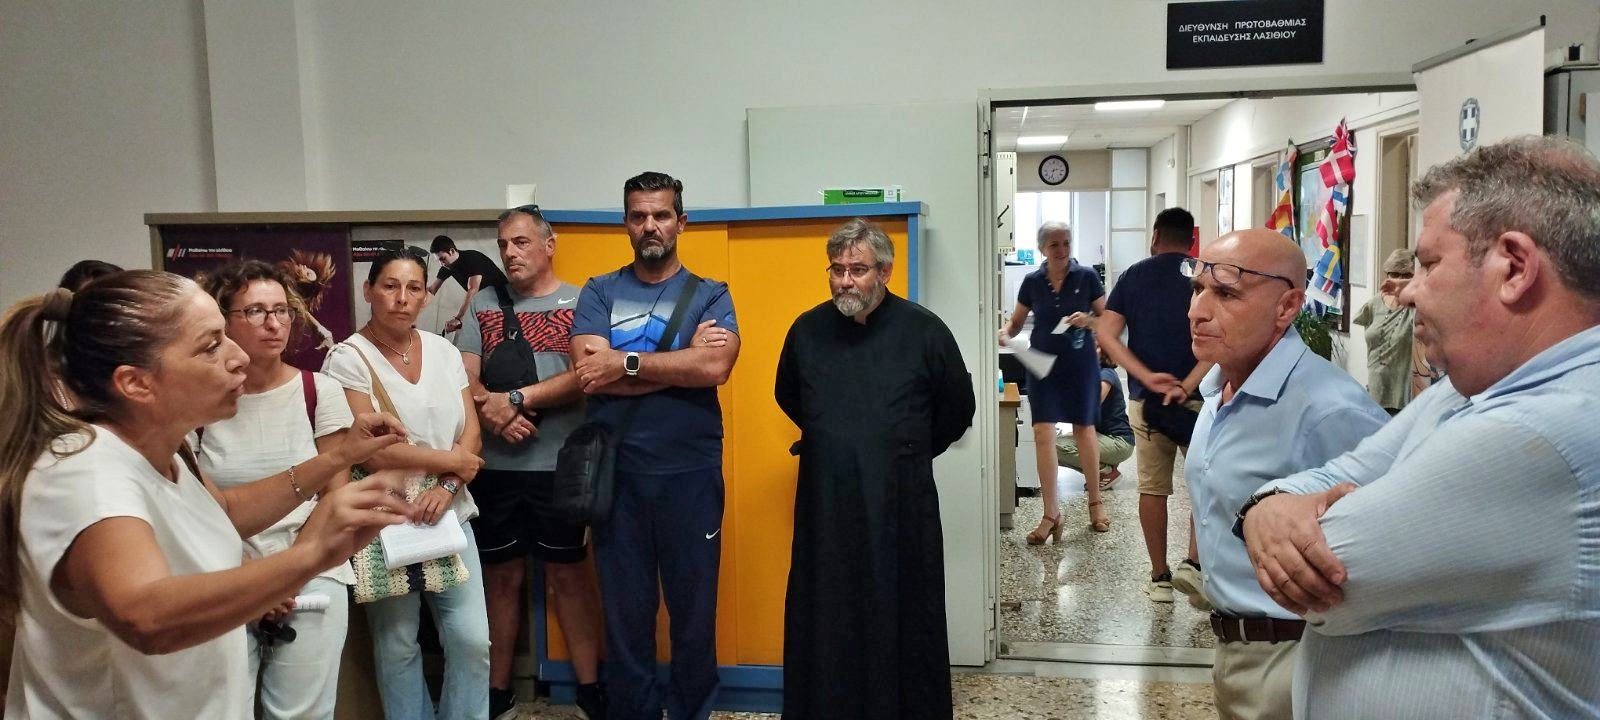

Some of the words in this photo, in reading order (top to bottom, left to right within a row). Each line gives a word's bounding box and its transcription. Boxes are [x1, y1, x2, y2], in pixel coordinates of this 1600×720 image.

[1178, 22, 1229, 32] ΔΙΕΥΘΥΝΣΗ
[1234, 18, 1307, 29] ΠΡΩΤΟΒΑΘΜΙΑΣ
[1192, 33, 1251, 43] ΕΚΠΑΙΔΕΥΣΗΣ
[1252, 30, 1297, 41] ΛΑΣΙΘΙΟΥ
